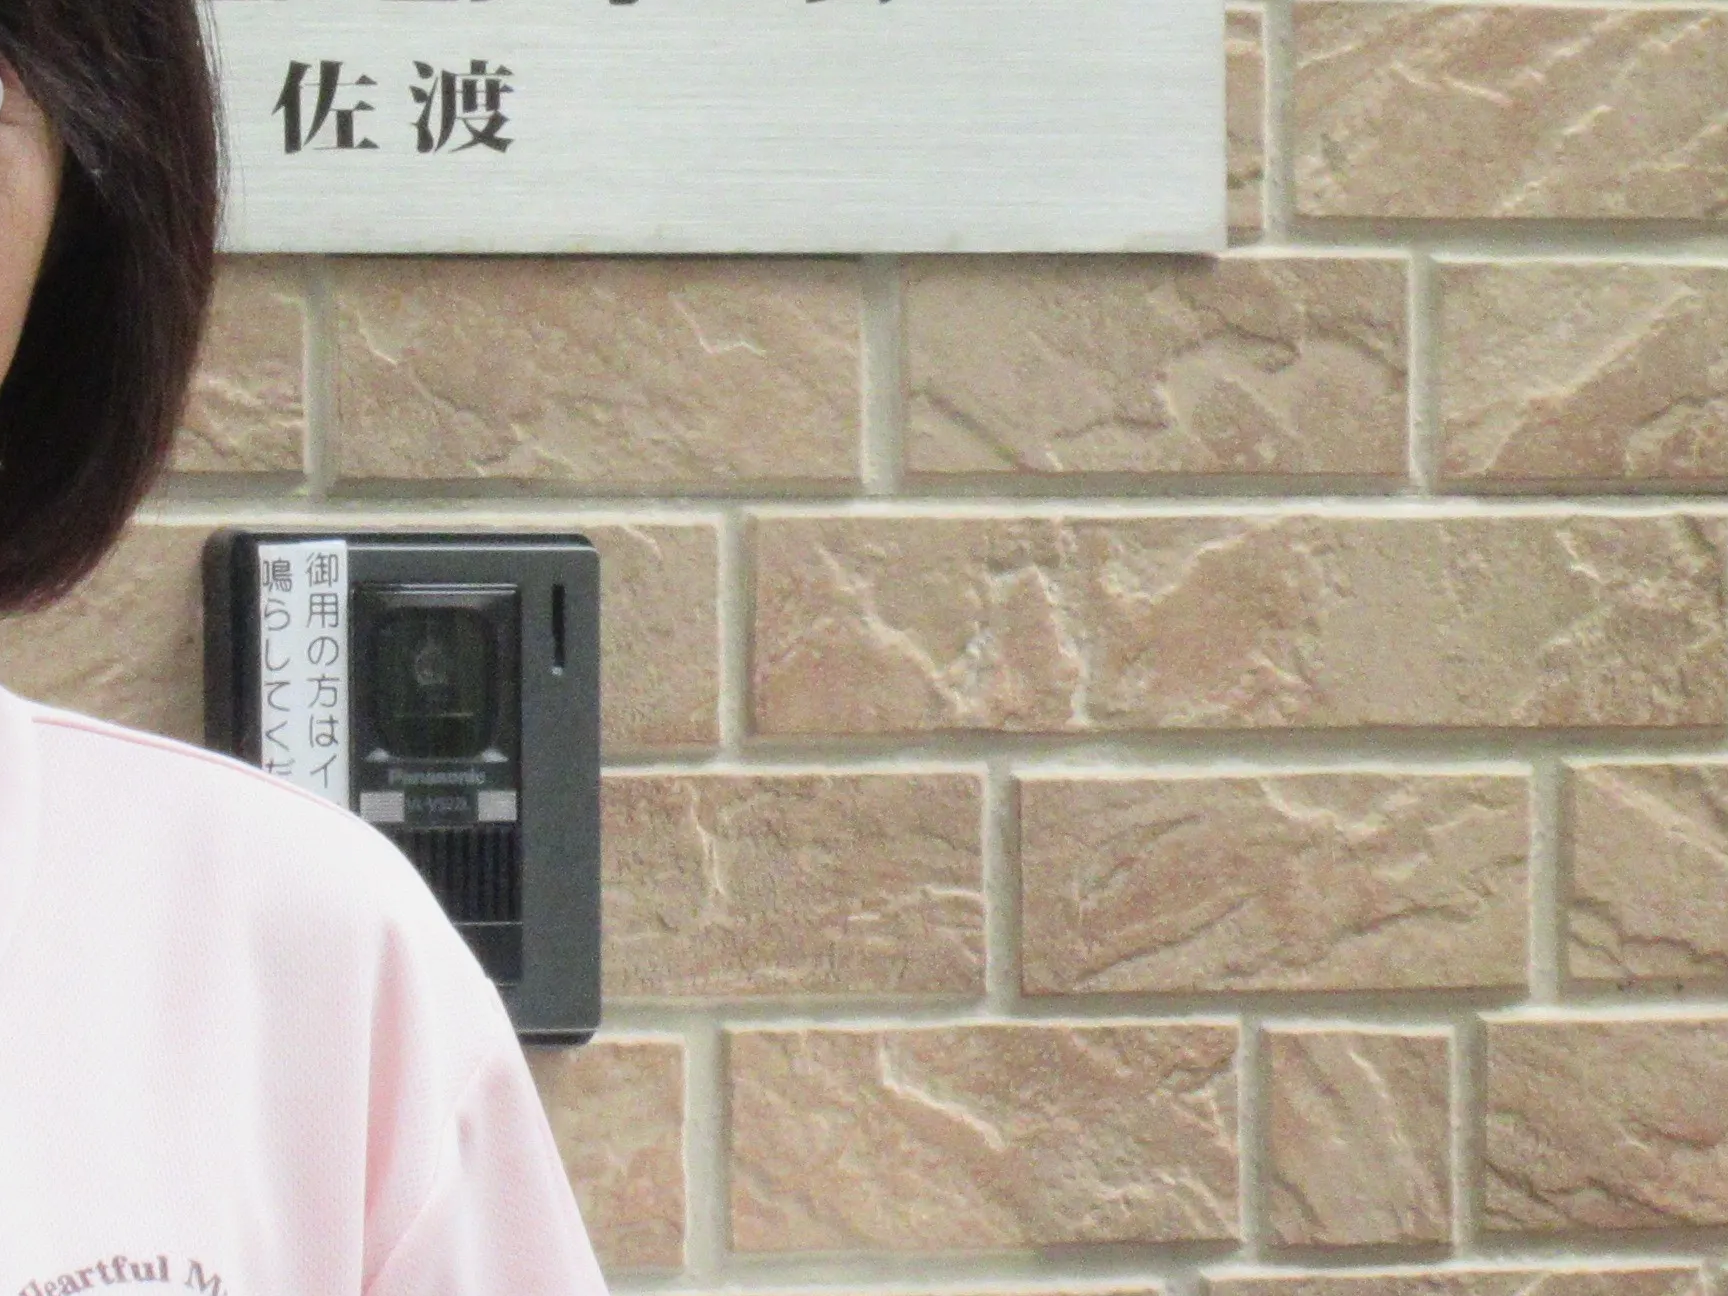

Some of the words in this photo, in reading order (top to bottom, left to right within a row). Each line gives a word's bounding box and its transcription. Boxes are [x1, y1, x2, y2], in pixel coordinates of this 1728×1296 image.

[272, 58, 515, 154] 佐渡
[306, 552, 341, 805] 御用の方はイ
